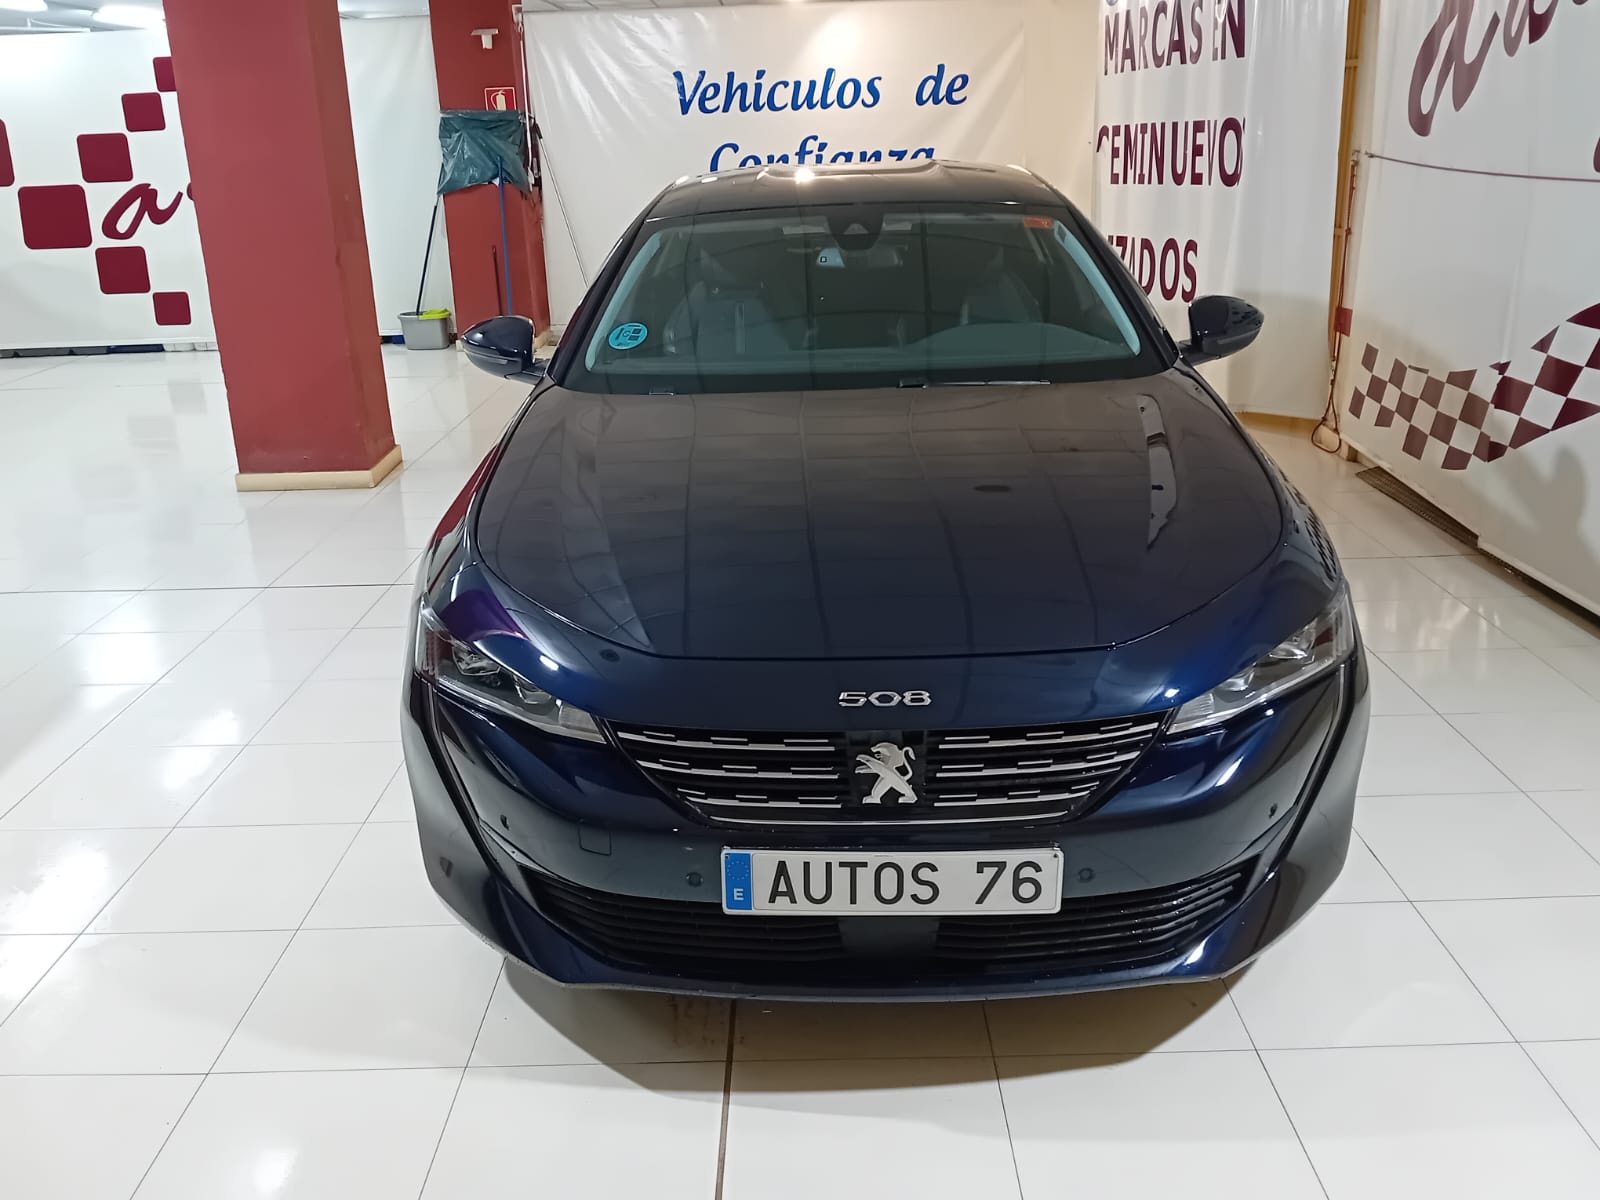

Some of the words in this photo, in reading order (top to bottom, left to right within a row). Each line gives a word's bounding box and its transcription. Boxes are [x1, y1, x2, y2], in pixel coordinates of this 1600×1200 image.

[1104, 0, 1203, 76] MARCAS
[915, 63, 969, 106] de
[1096, 116, 1246, 187] EMINUEVO
[838, 690, 932, 707] 508
[733, 888, 744, 901] E
[768, 860, 940, 905] AUTOS
[975, 860, 1043, 904] 76
